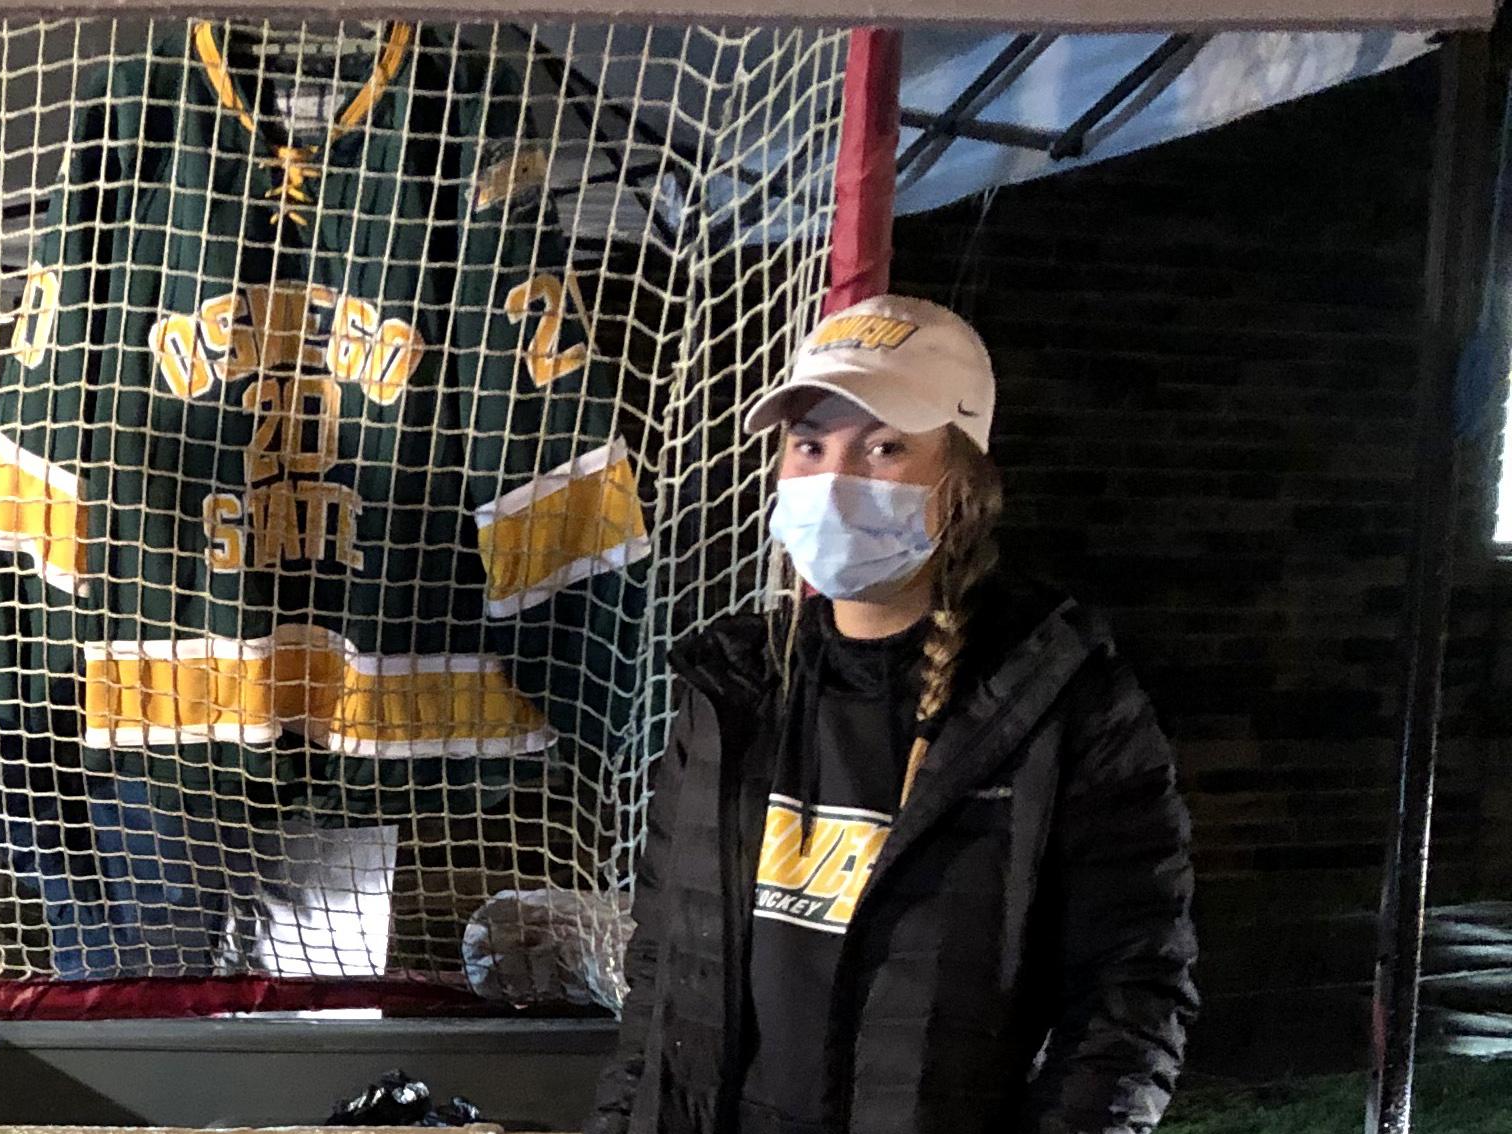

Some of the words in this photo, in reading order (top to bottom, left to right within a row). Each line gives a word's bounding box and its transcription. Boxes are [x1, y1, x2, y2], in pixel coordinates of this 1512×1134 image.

[148, 280, 425, 406] OSWEGO
[242, 377, 342, 482] 20
[202, 481, 364, 574] STATE
[756, 890, 822, 917] OCKEY
